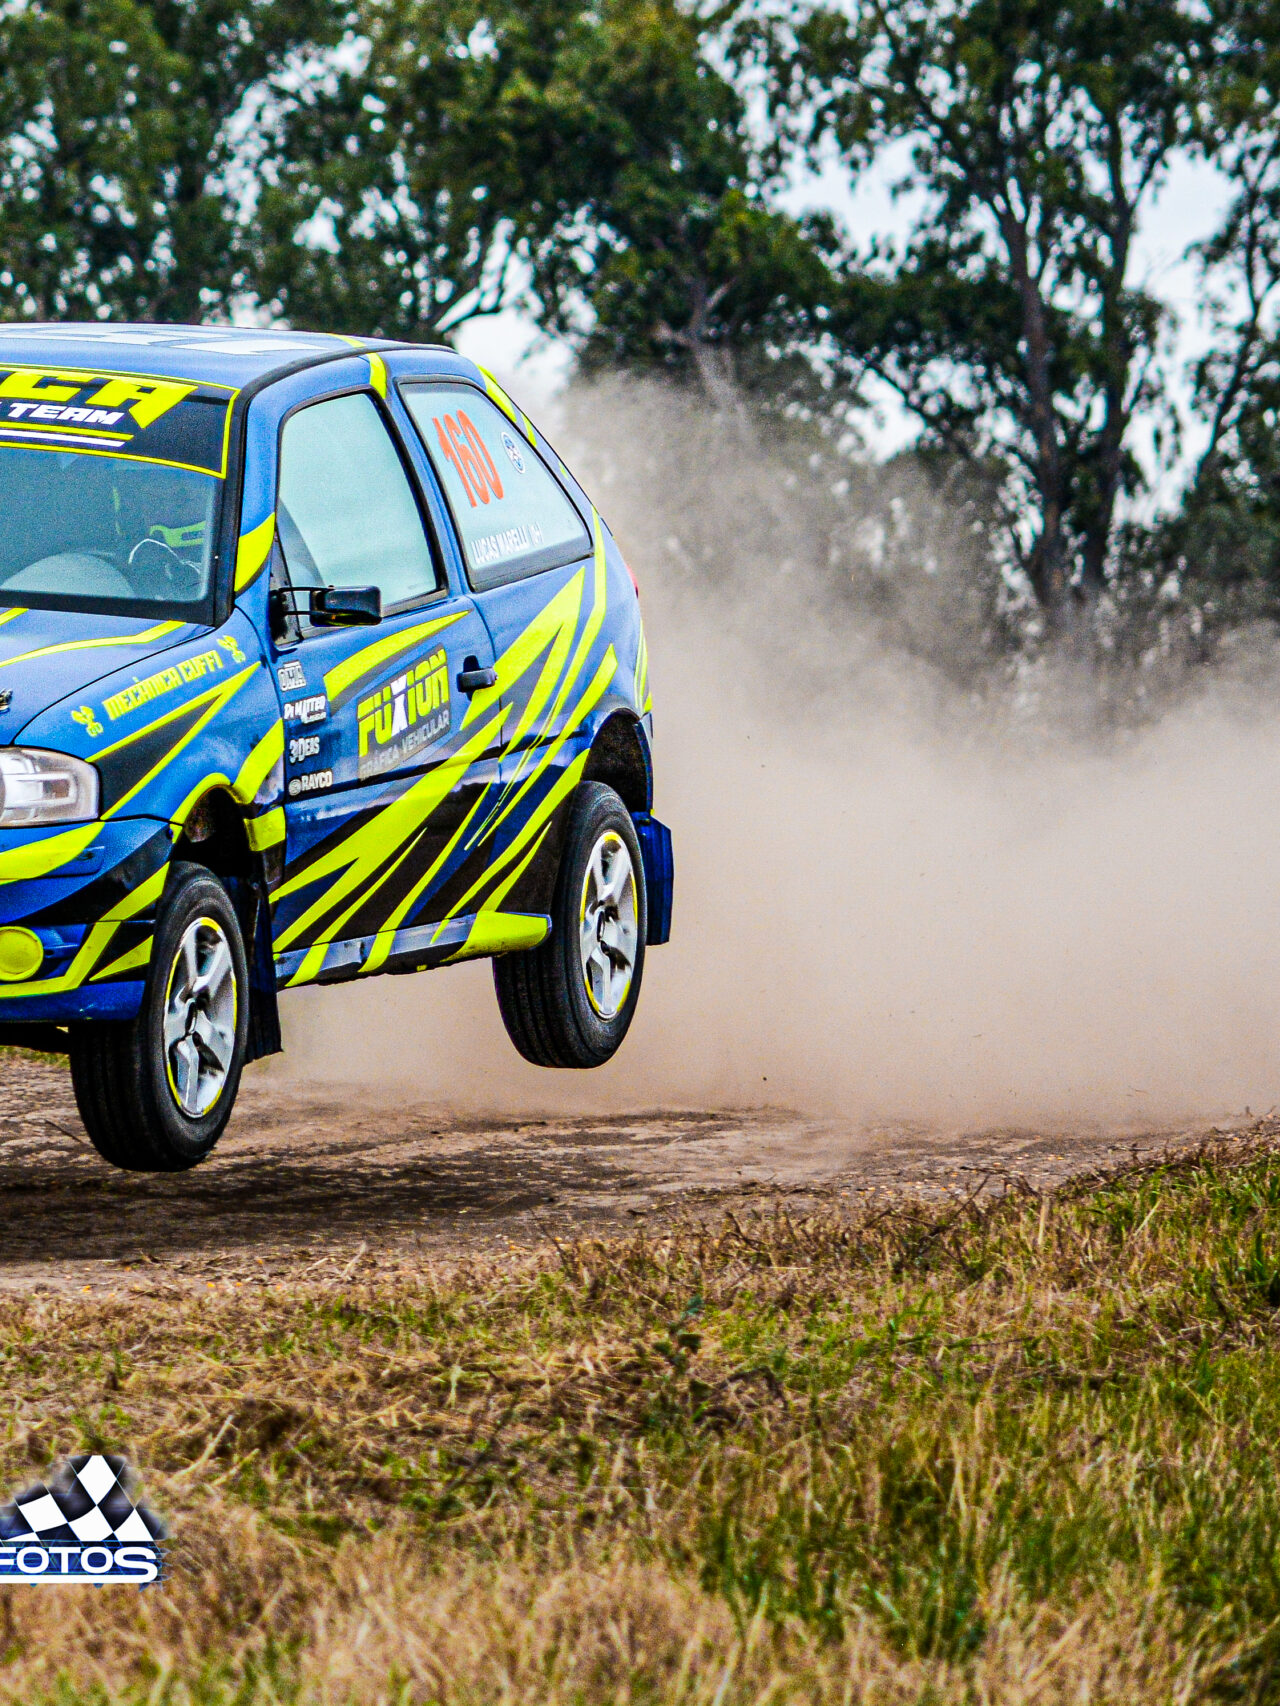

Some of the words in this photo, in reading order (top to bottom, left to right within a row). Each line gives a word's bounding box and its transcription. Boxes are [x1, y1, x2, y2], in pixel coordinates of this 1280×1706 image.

[7, 402, 125, 425] TEAM
[432, 409, 504, 508] 160
[301, 770, 333, 791] RAYCO
